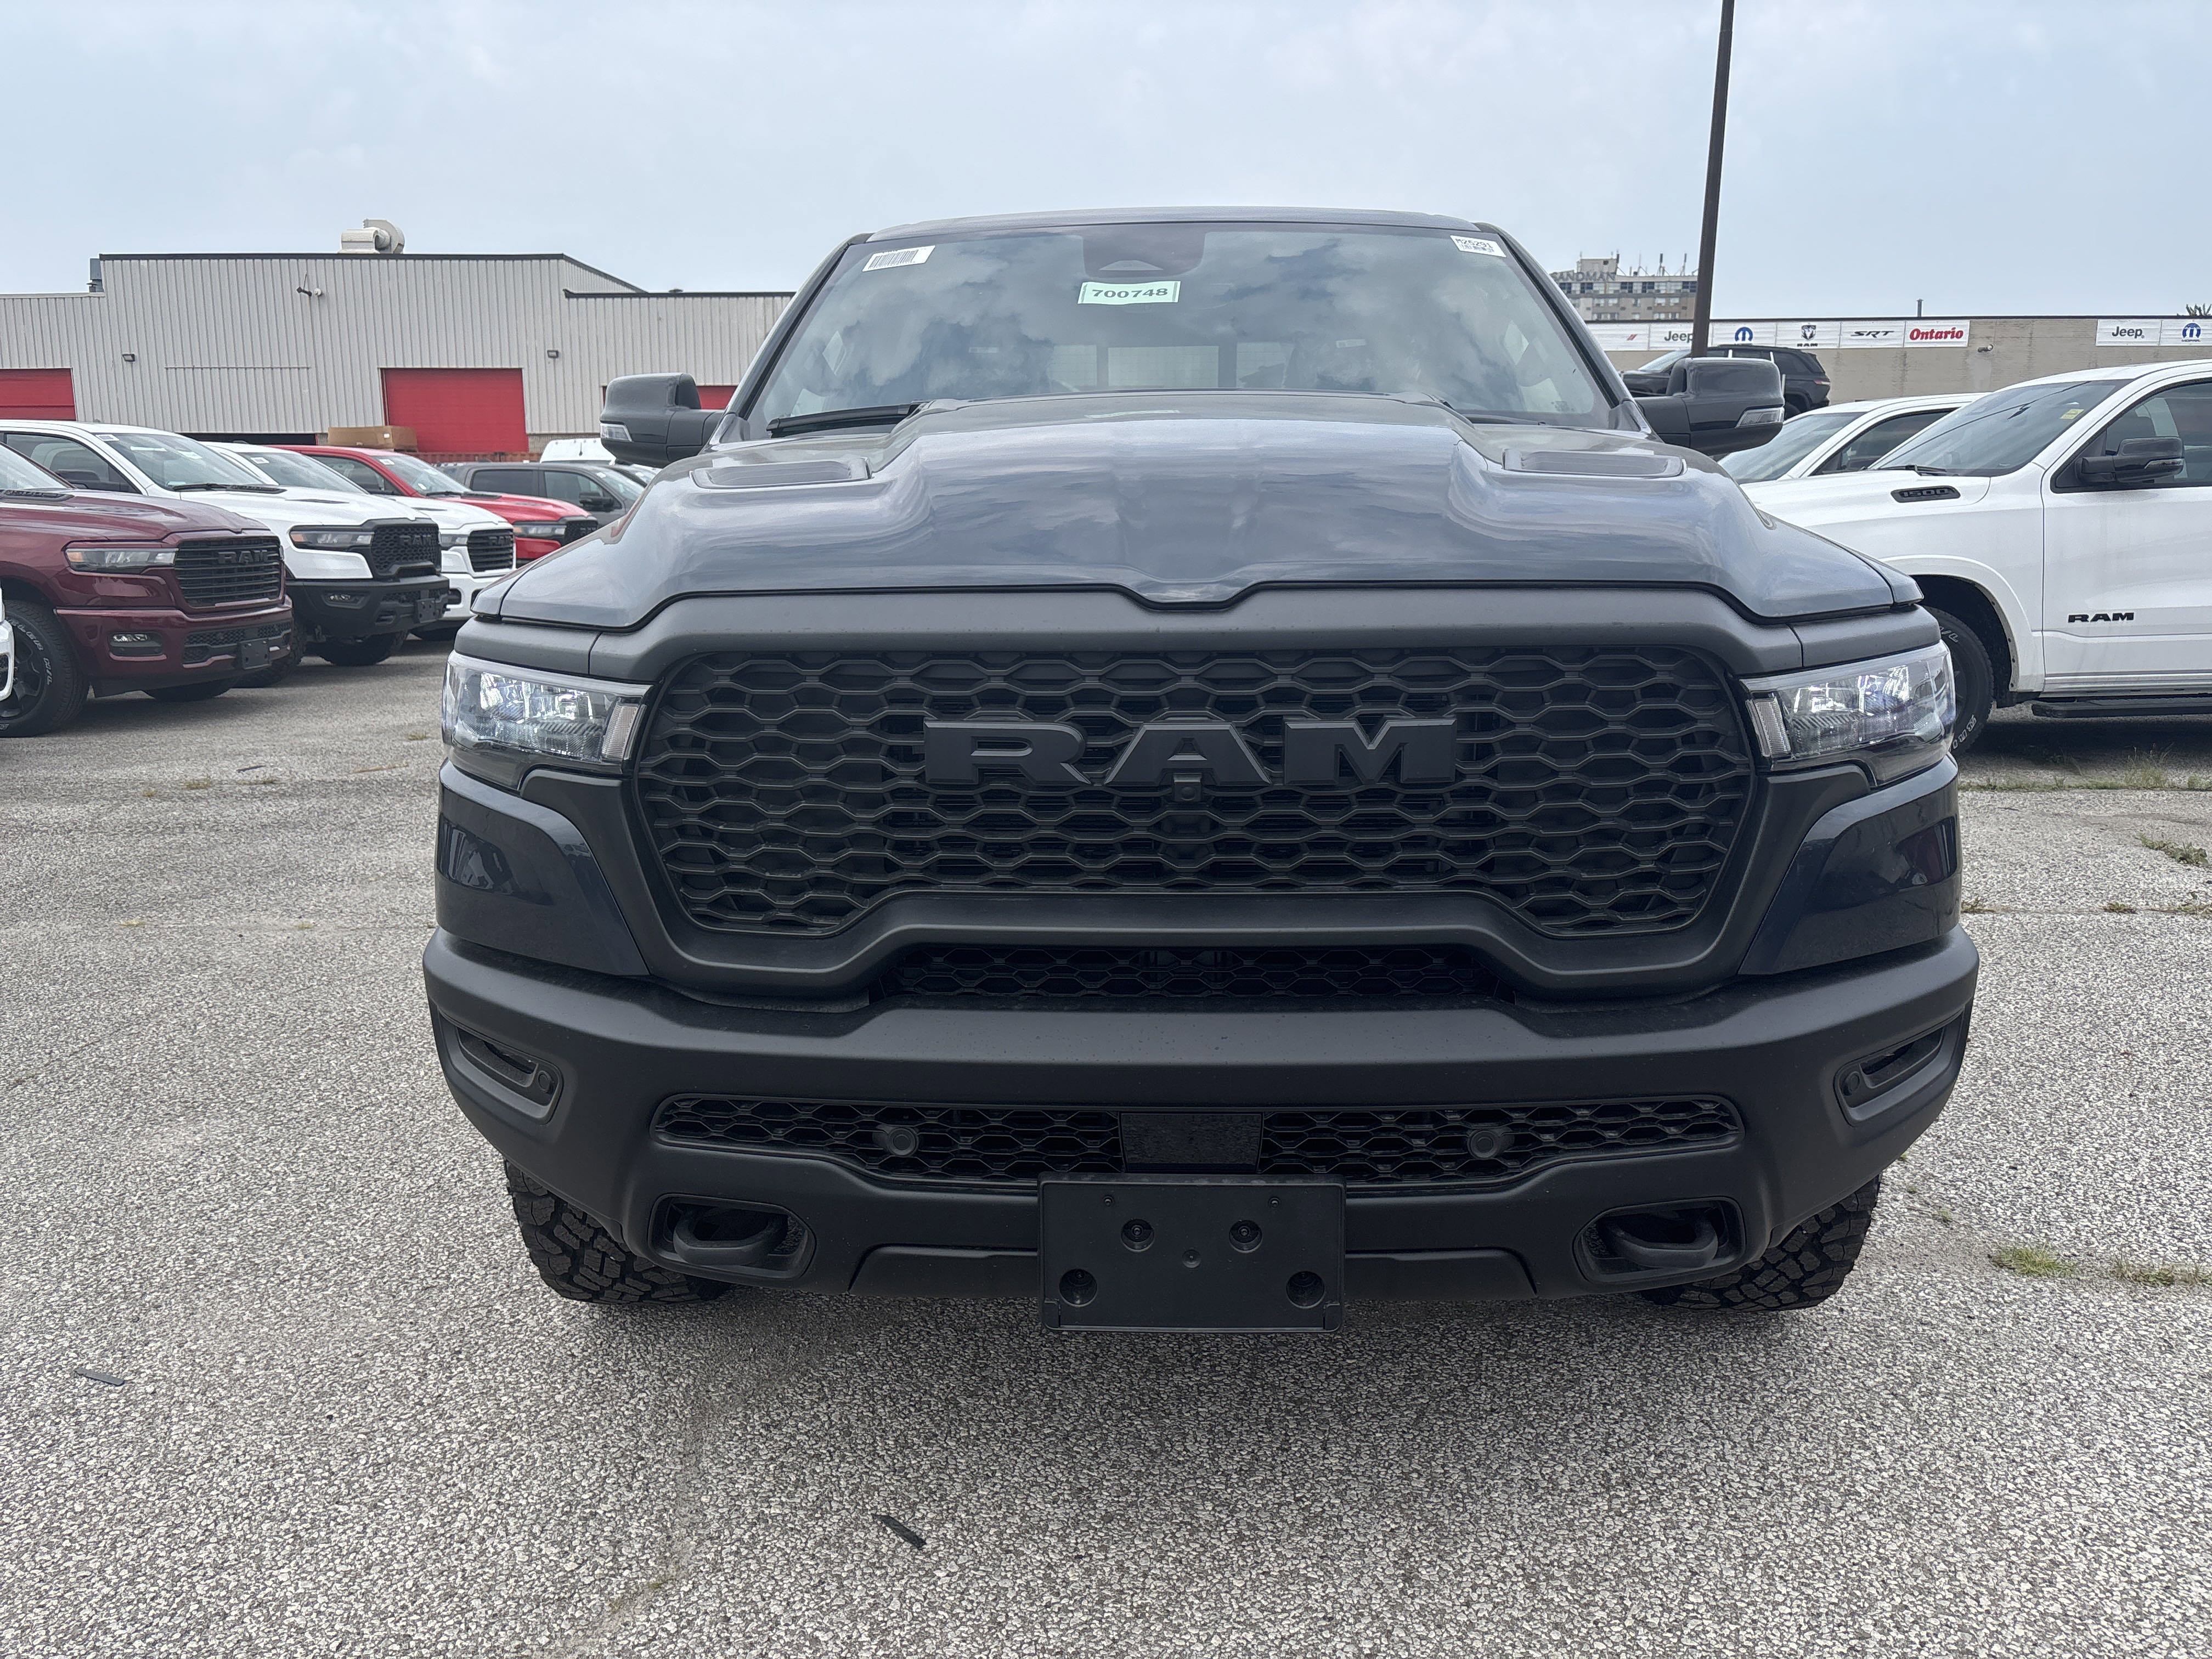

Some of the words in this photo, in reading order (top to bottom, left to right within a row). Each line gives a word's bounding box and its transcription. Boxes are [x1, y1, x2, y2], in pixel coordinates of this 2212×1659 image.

[1092, 288, 1168, 298] 700748
[1909, 327, 1964, 341] Ontario
[1903, 488, 1949, 497] 1500
[218, 550, 268, 564] RAM
[2068, 612, 2134, 623] RAM
[924, 719, 1457, 786] RAM
